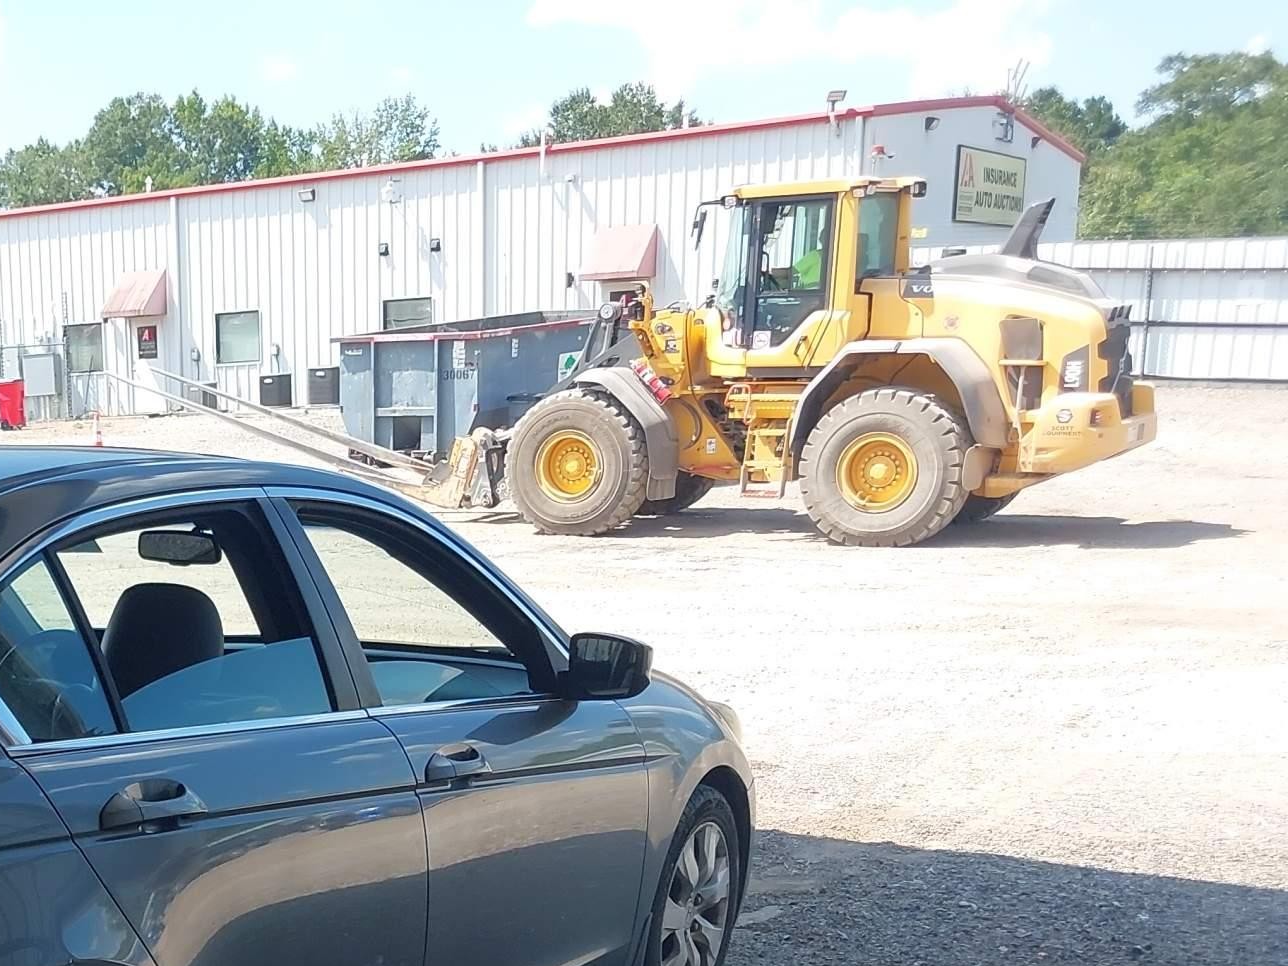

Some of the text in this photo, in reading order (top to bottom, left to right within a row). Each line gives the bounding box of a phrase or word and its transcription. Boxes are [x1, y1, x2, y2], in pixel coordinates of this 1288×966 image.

[983, 167, 1018, 188] INSURANCE
[974, 191, 993, 208] AUTO
[443, 368, 475, 380] 30067
